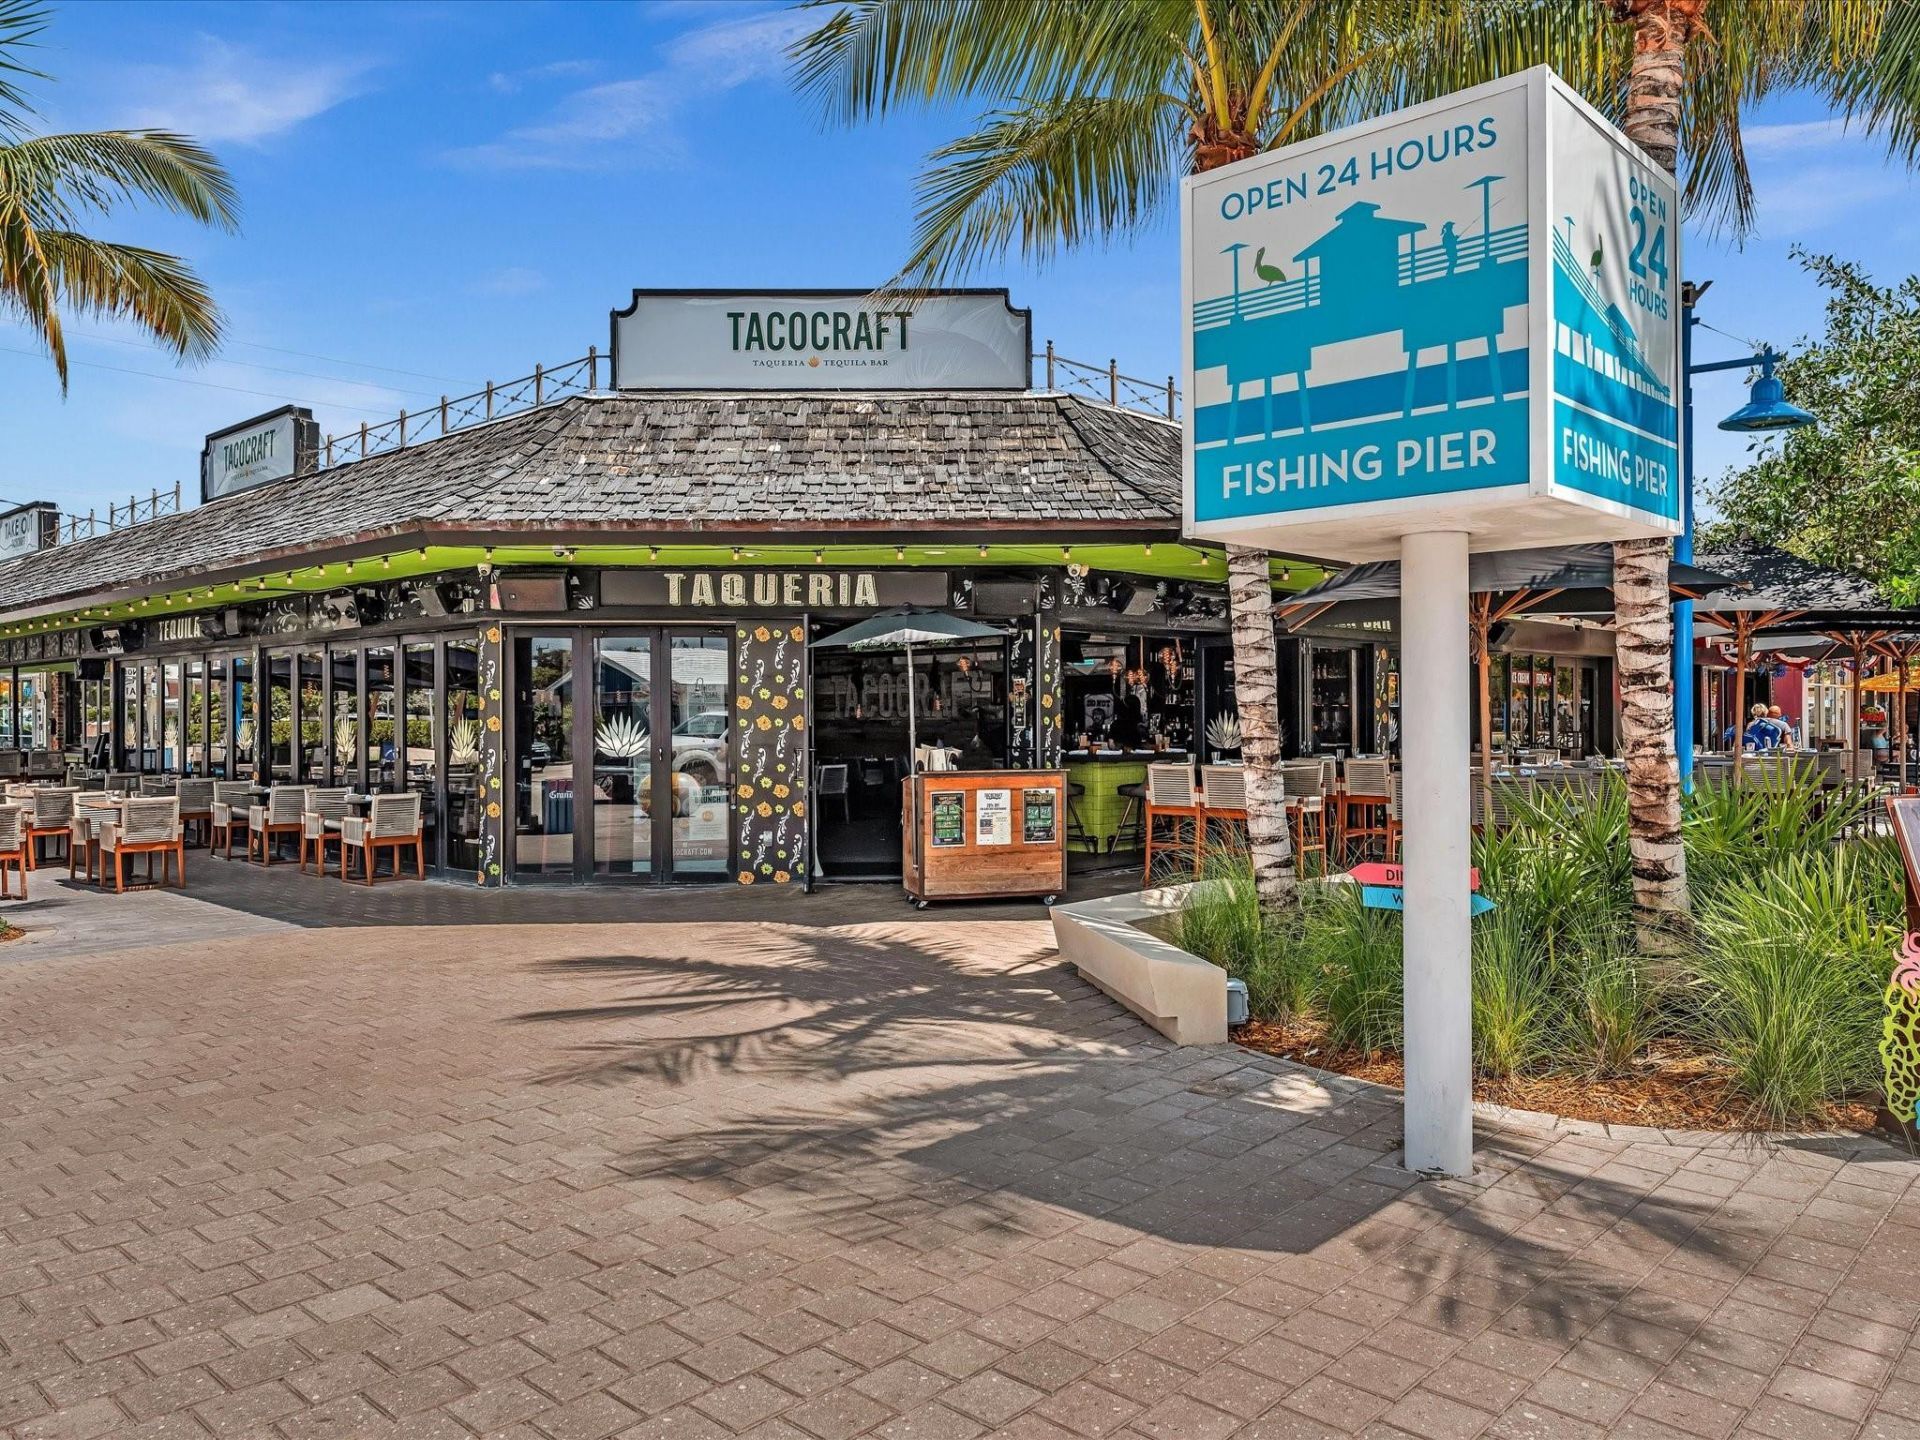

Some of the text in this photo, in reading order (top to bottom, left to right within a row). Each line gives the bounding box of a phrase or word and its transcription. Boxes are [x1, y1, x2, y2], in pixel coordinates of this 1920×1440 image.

[1221, 117, 1498, 221] OPEN 24 HOURS
[1629, 176, 1667, 222] OPEN
[1628, 205, 1669, 291] 24
[1629, 278, 1668, 320] HOURS
[726, 311, 913, 351] TACOCRAFT
[753, 359, 889, 368] TAQUERIA TEQUILA BAR
[223, 428, 276, 472] TACOCRAFT
[1222, 428, 1497, 499] FISHING PIER
[1563, 427, 1668, 497] FISHING PIER
[664, 573, 879, 607] TAQUERIA
[158, 616, 202, 641] TEQUILA
